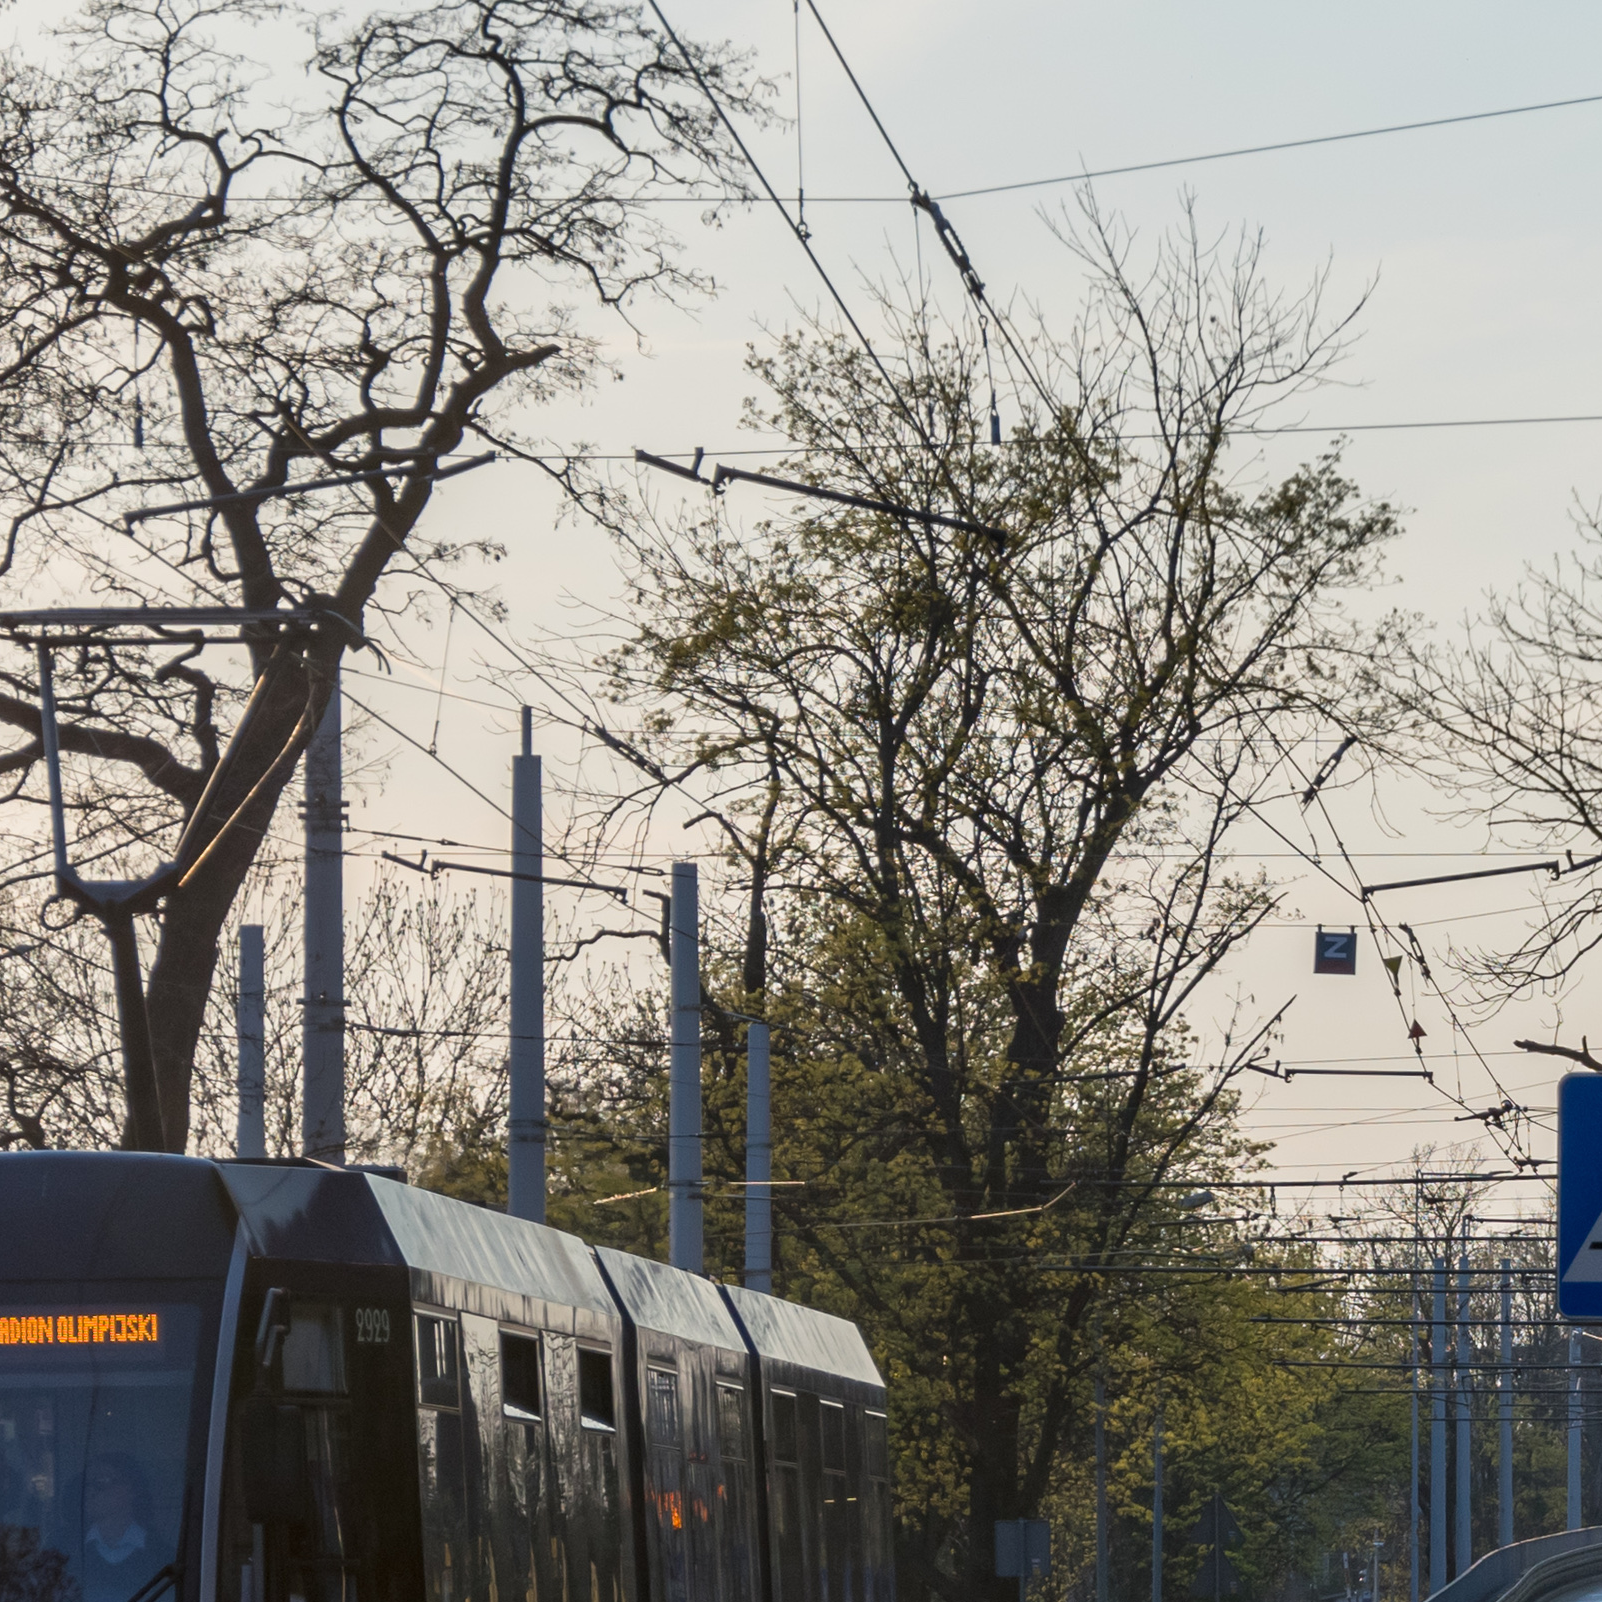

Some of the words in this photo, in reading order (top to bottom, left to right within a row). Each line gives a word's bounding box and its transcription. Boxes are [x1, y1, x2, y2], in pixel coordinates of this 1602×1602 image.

[1324, 936, 1348, 959] Z
[57, 1314, 157, 1343] OLIMPIJSKI
[356, 1308, 390, 1342] 2929
